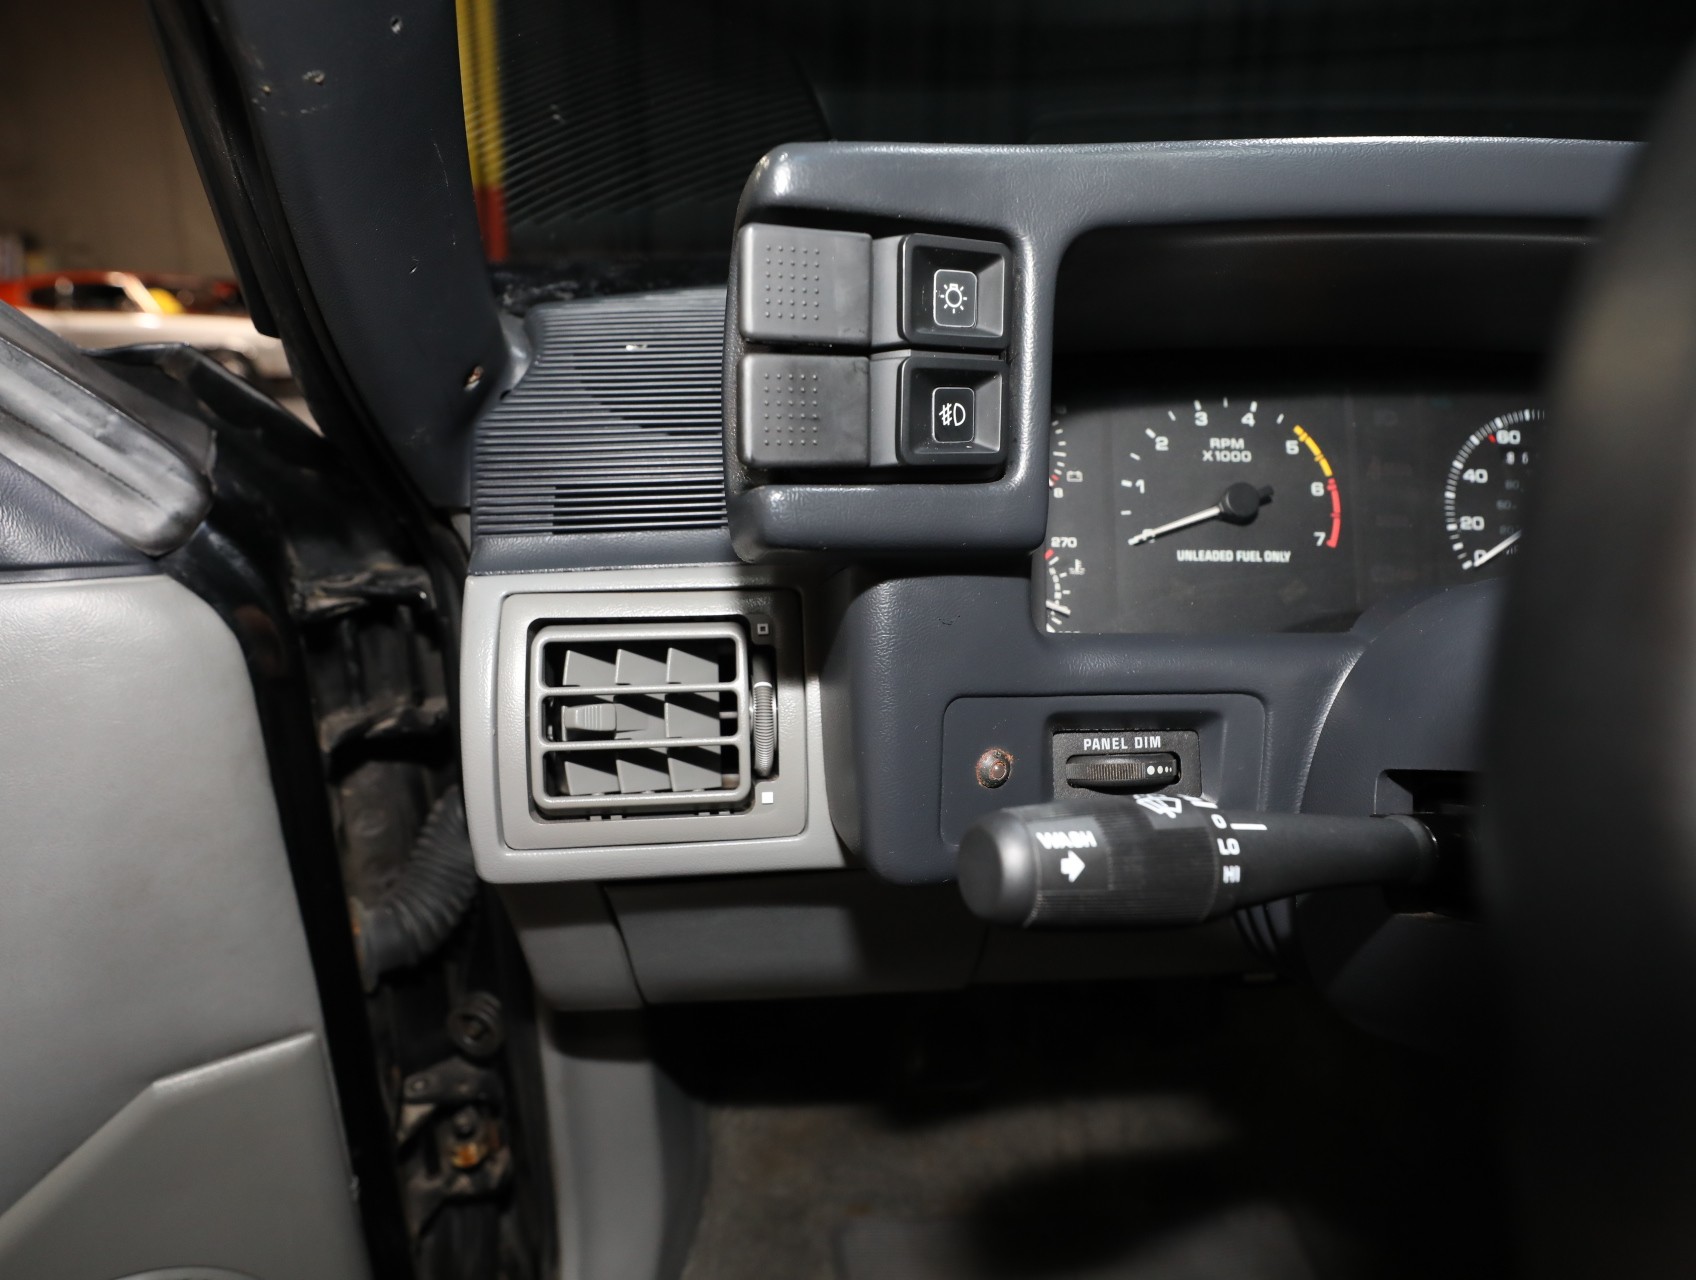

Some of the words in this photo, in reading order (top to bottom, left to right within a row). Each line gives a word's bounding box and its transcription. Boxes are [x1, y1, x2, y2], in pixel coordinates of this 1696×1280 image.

[1194, 411, 1209, 427] 3
[1241, 411, 1256, 428] 4
[1154, 435, 1169, 451] 2
[1209, 437, 1245, 450] RPM
[1285, 439, 1300, 455] 5
[1202, 449, 1252, 463] X1000
[1462, 468, 1488, 484] 40
[1135, 478, 1145, 494] 1
[1310, 481, 1325, 497] 6
[1459, 515, 1485, 531] 20
[1050, 536, 1078, 549] 270
[1314, 531, 1326, 547] 7
[1176, 549, 1234, 563] UNLEADED
[1236, 550, 1263, 563] FUEL
[1264, 550, 1292, 563] ONLY
[1084, 737, 1128, 751] PANEL
[1134, 735, 1161, 749] DIM
[1035, 830, 1098, 850] WASH
[1216, 837, 1241, 856] LO
[1222, 864, 1241, 884] HI
